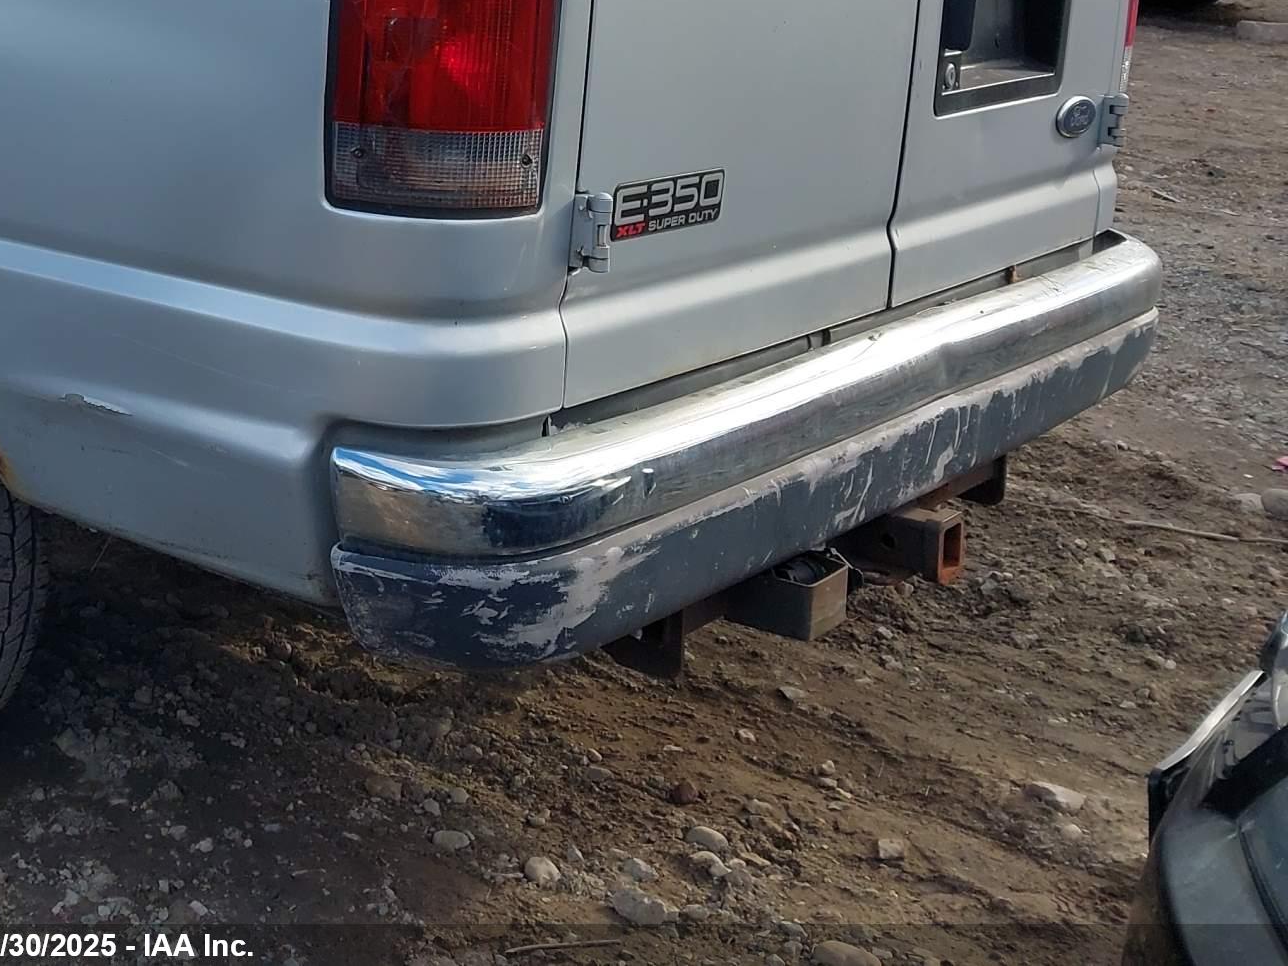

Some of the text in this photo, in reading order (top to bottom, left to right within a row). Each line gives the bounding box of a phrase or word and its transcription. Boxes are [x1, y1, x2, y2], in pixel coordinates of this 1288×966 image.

[616, 208, 719, 238] XLT SUPER DUTY
